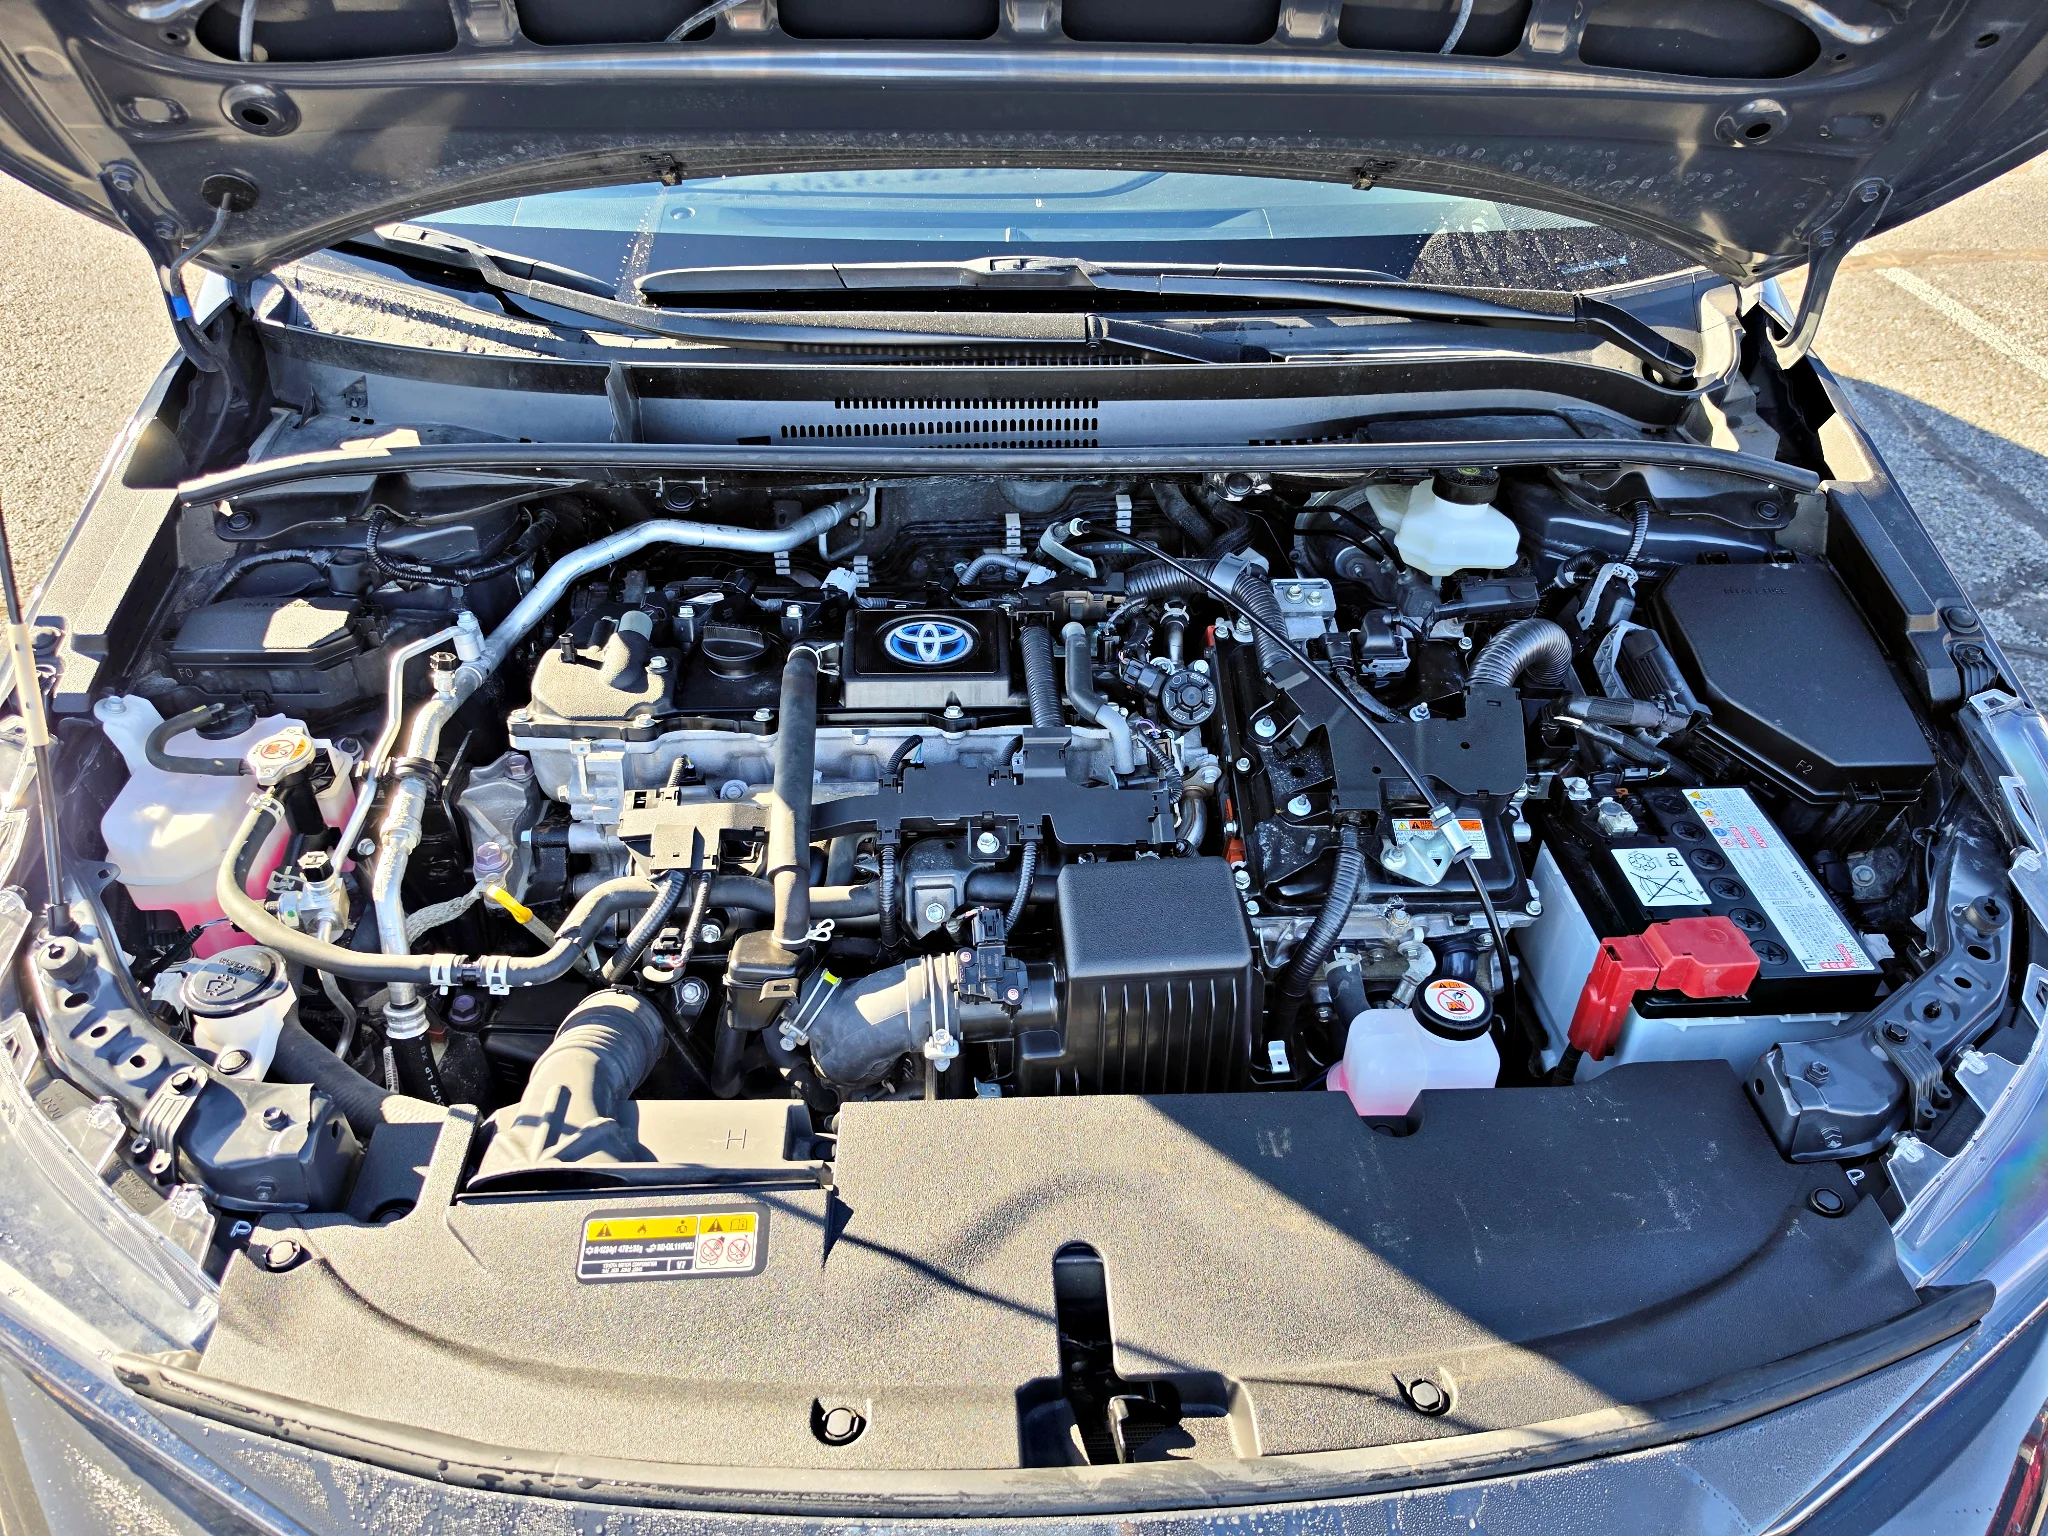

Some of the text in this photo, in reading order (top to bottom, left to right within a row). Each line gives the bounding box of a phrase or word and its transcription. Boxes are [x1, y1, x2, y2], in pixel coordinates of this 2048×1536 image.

[1795, 759, 1814, 775] F2
[1665, 852, 1684, 867] Pb
[1790, 870, 1810, 890] YUASA
[424, 1067, 434, 1081] LP
[725, 1128, 747, 1150] H
[1845, 1168, 1866, 1186] P
[230, 1220, 252, 1237] P
[676, 1260, 687, 1269] V7
